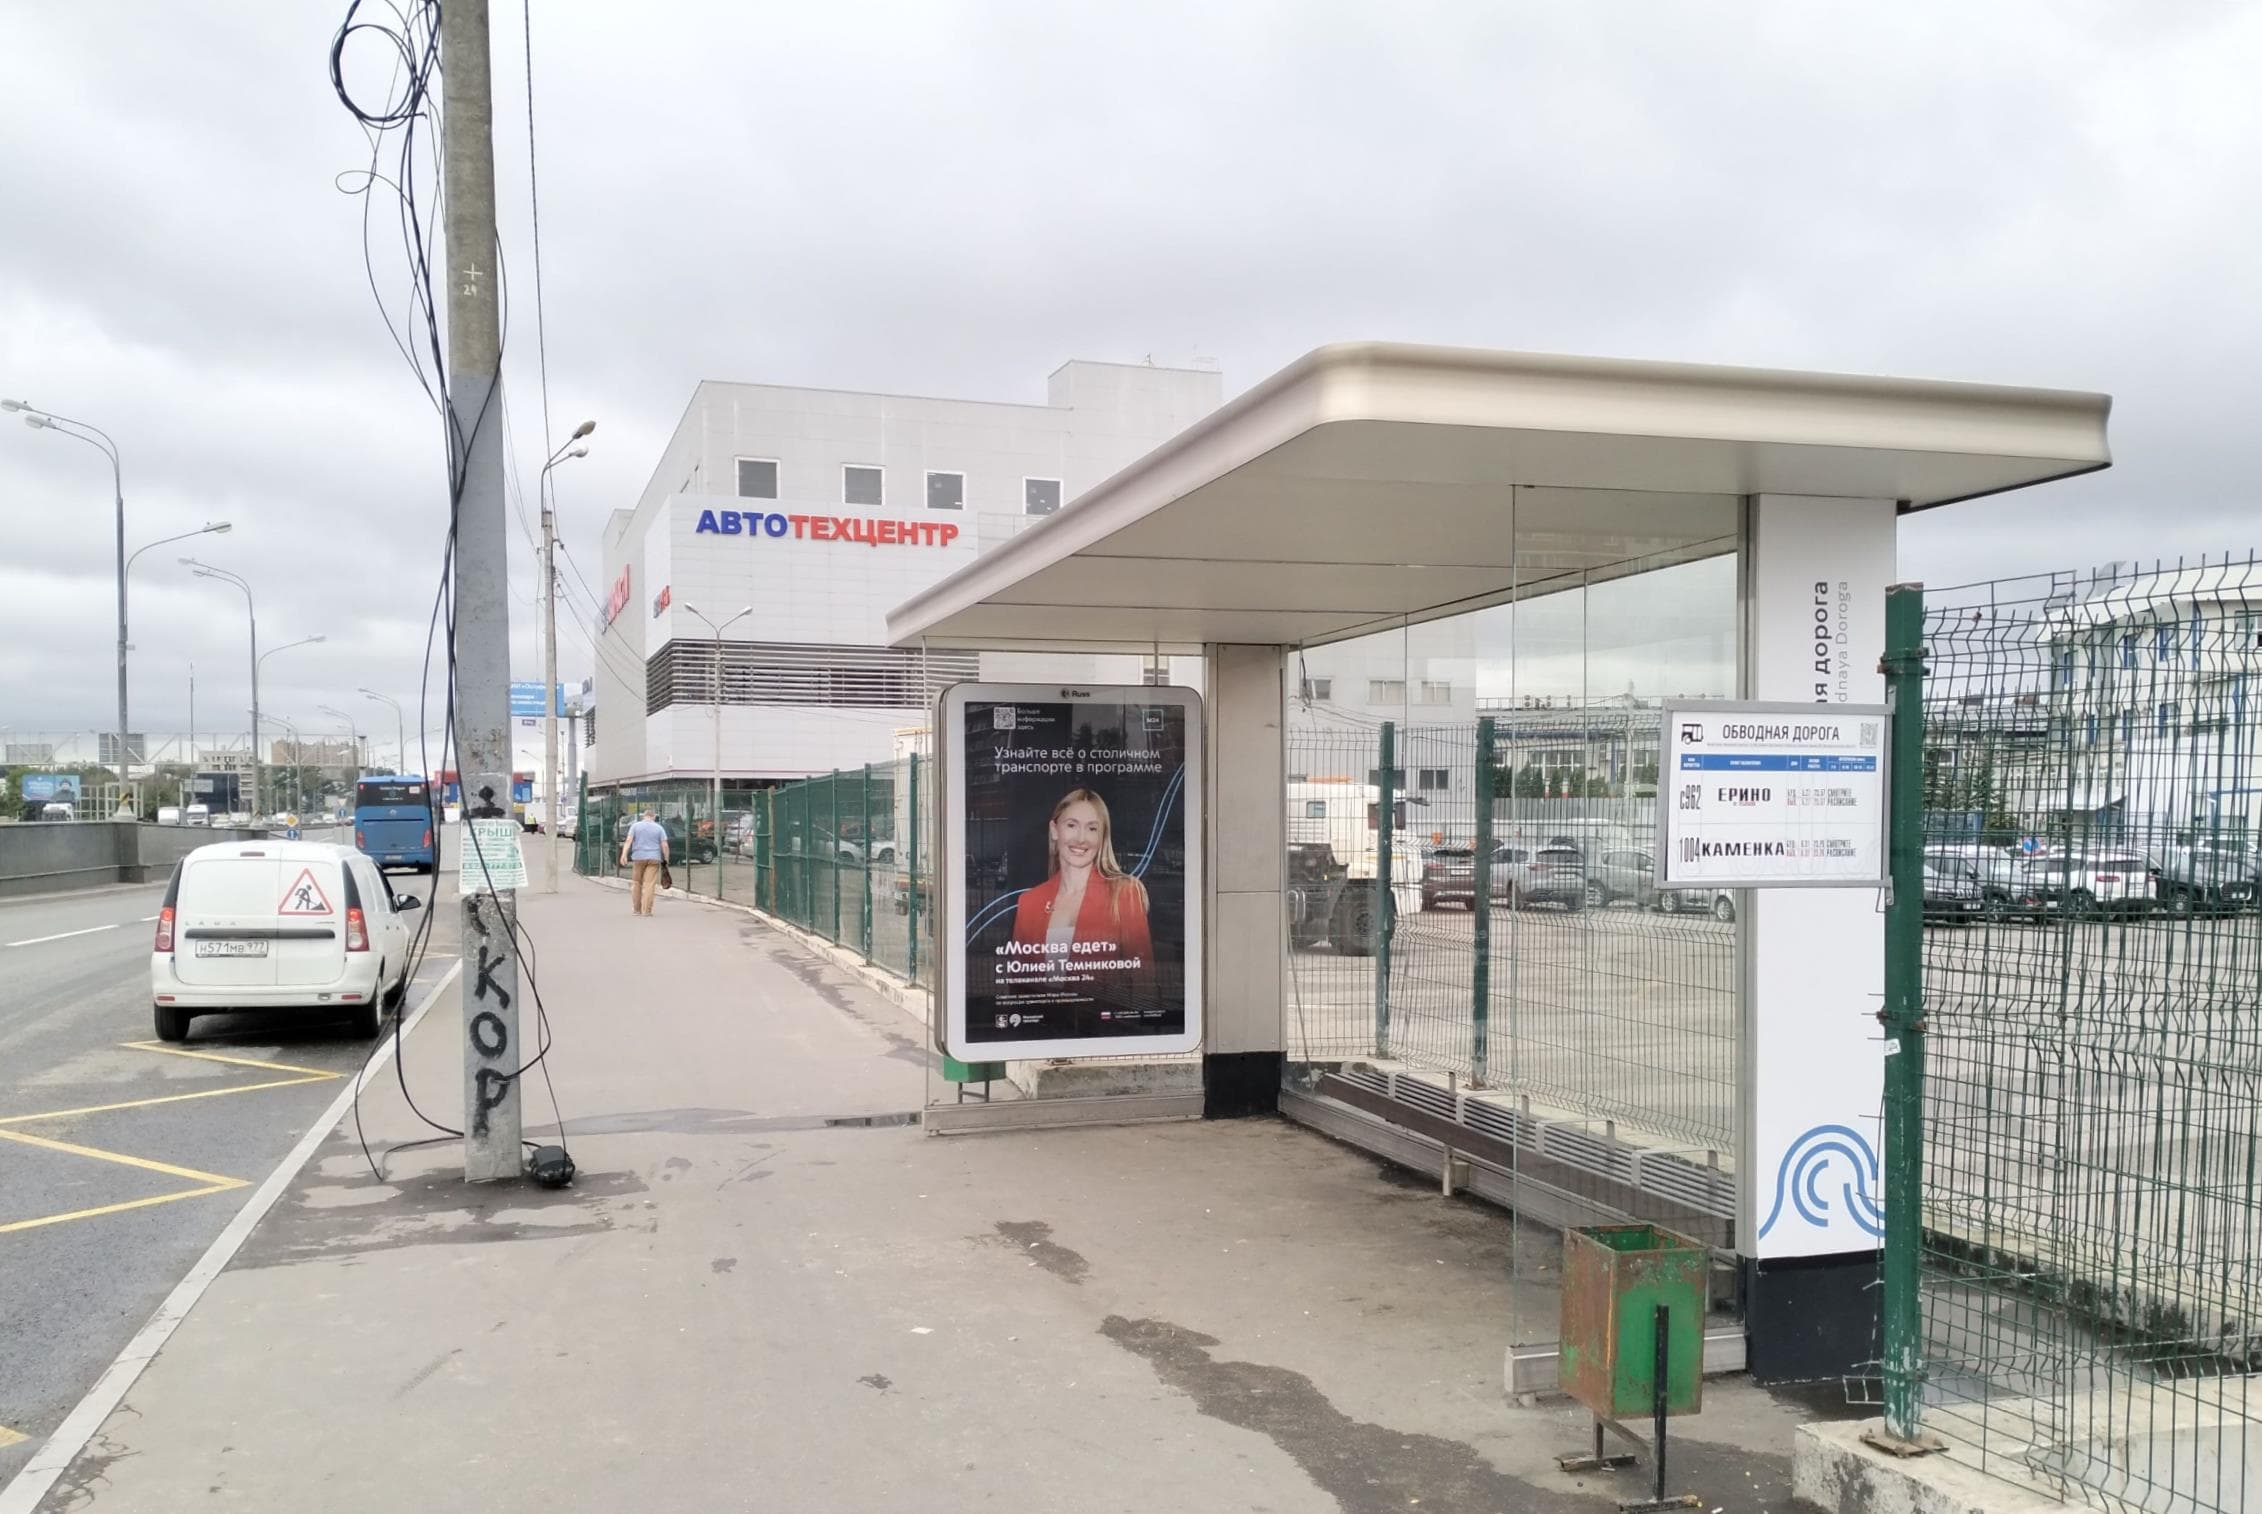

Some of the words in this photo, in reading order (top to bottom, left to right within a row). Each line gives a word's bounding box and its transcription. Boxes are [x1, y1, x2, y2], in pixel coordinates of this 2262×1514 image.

[695, 509, 959, 548] АВТОТЕХЦЕНТР
[1835, 580, 1851, 645] Doroga
[1815, 581, 1832, 675] дорога
[1834, 650, 1850, 703] dnaya
[1722, 724, 1789, 742] ОБВОДНАЯ
[1793, 725, 1840, 743] ДОРОГА
[994, 746, 1048, 760] Узнайте
[1051, 747, 1074, 759] всё
[1077, 750, 1086, 759] о
[1089, 749, 1161, 760] столичном
[995, 762, 1072, 775] транспорте
[1076, 763, 1084, 773] в
[1088, 763, 1163, 775] программе
[1717, 787, 1771, 803] ЕРИНО
[1679, 836, 1700, 863] 1004
[1702, 841, 1785, 857] КАМЕНКА
[995, 940, 1068, 955] «Москва
[1071, 940, 1117, 954] едет»
[995, 963, 1003, 974] с
[1006, 959, 1055, 974] Юлией
[1058, 957, 1141, 971] Темниковой
[995, 977, 1005, 985] на
[1005, 976, 1047, 985] телеканале
